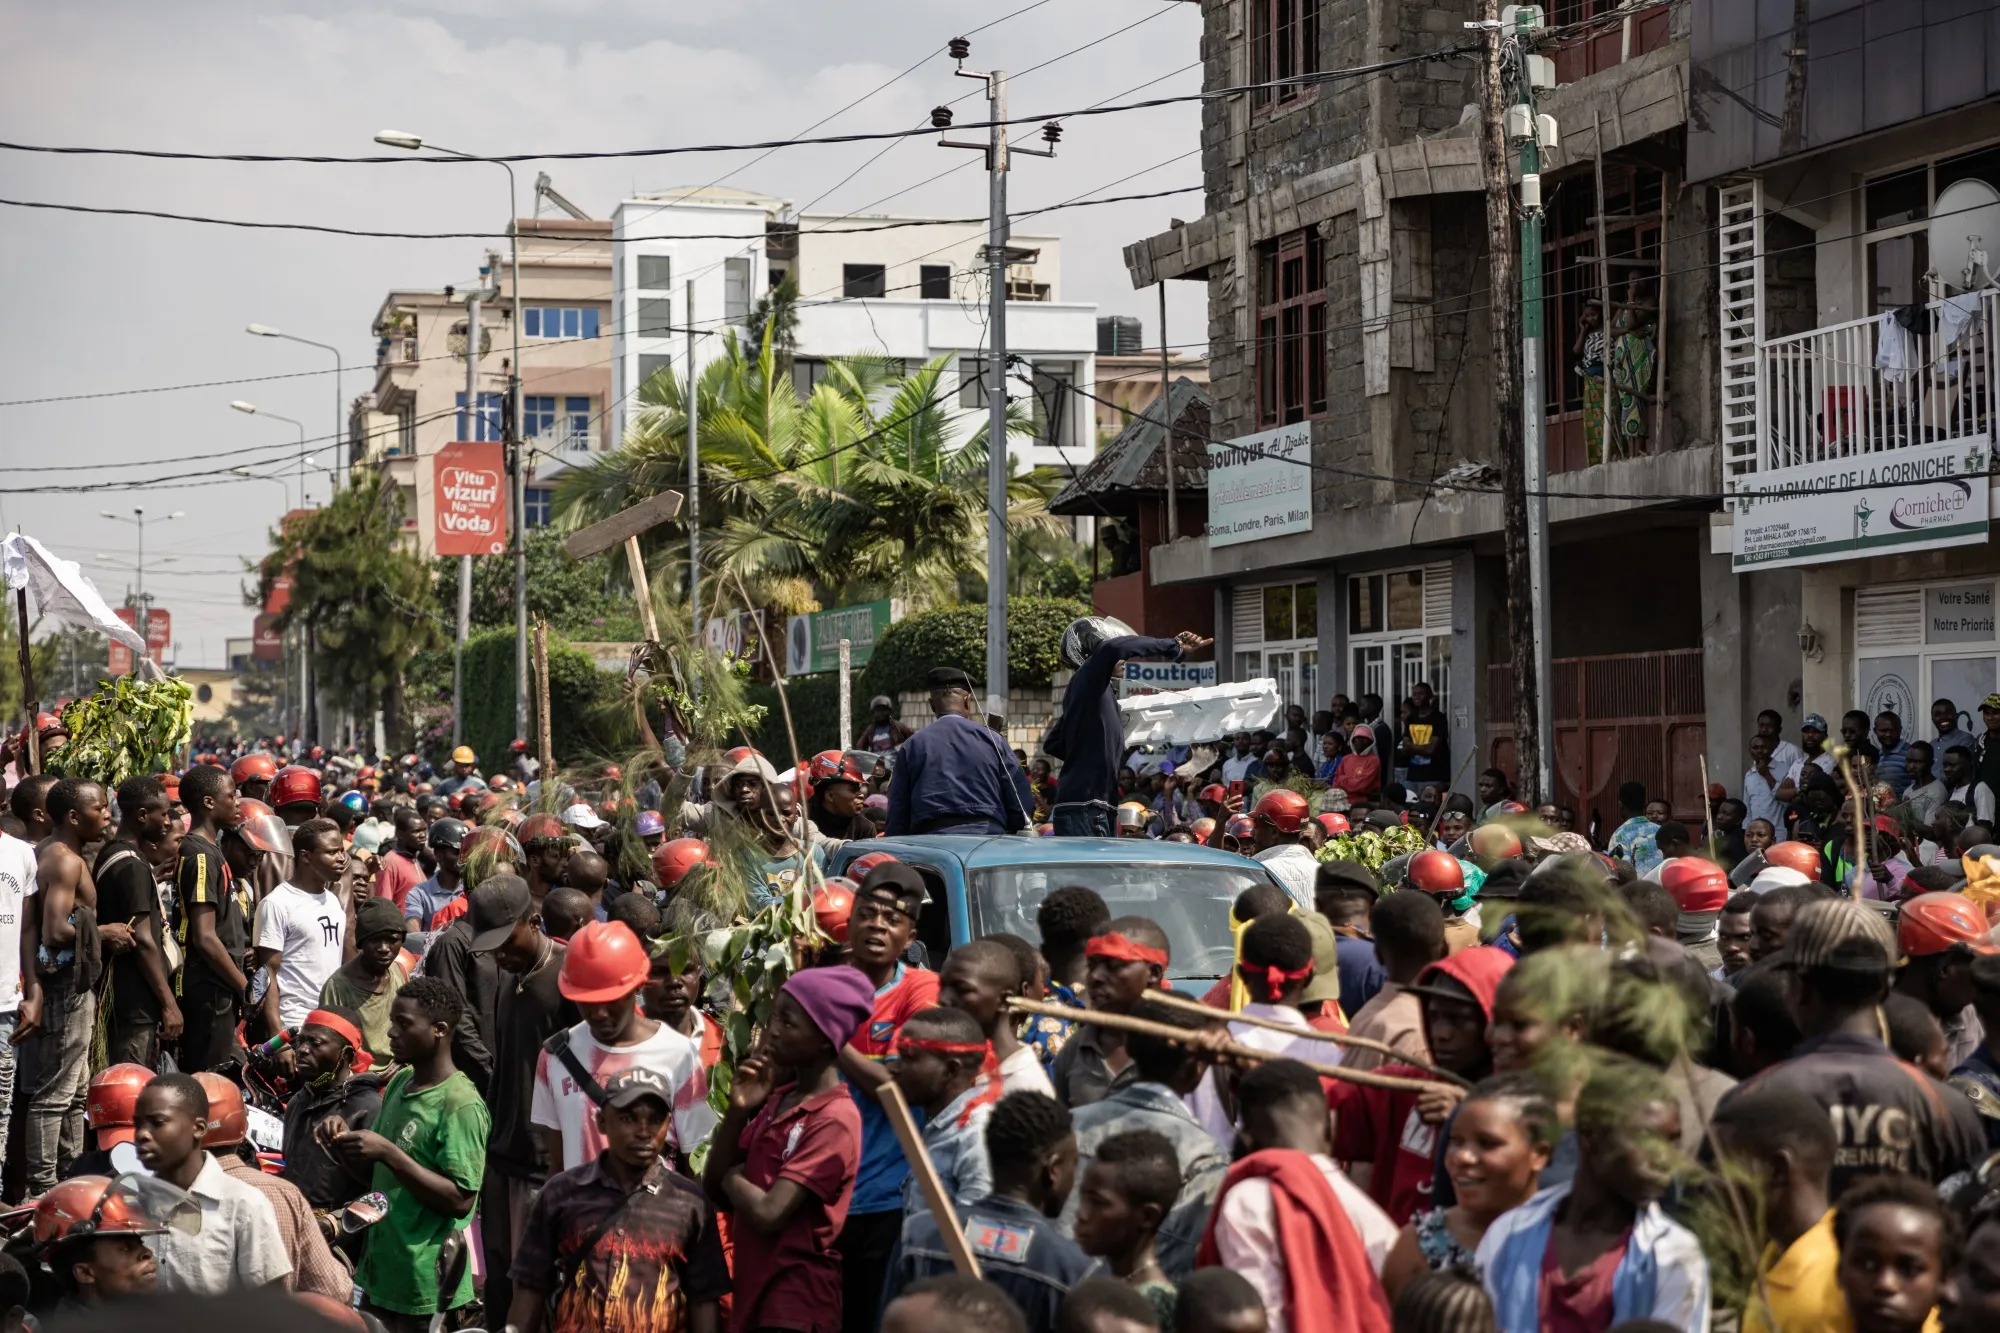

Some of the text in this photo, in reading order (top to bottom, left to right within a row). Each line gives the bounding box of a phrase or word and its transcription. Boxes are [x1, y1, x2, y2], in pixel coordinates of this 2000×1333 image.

[1208, 442, 1264, 470] BOUTIQUE
[454, 471, 485, 486] Vitu
[1759, 455, 1955, 505] PHARMACIE DE LA CORNICHE
[443, 483, 497, 504] vizuri
[451, 501, 467, 512] Na
[1893, 493, 1951, 517] Corniche
[443, 512, 490, 533] Voda
[1209, 510, 1309, 538] Goma, Londre, Paris, Milan
[1921, 513, 1955, 526] PHARMACY
[1938, 589, 1990, 605] Votre Santé
[1934, 616, 1994, 632] Notre Priorité
[1125, 663, 1214, 684] Boutique
[618, 1070, 663, 1090] FILA
